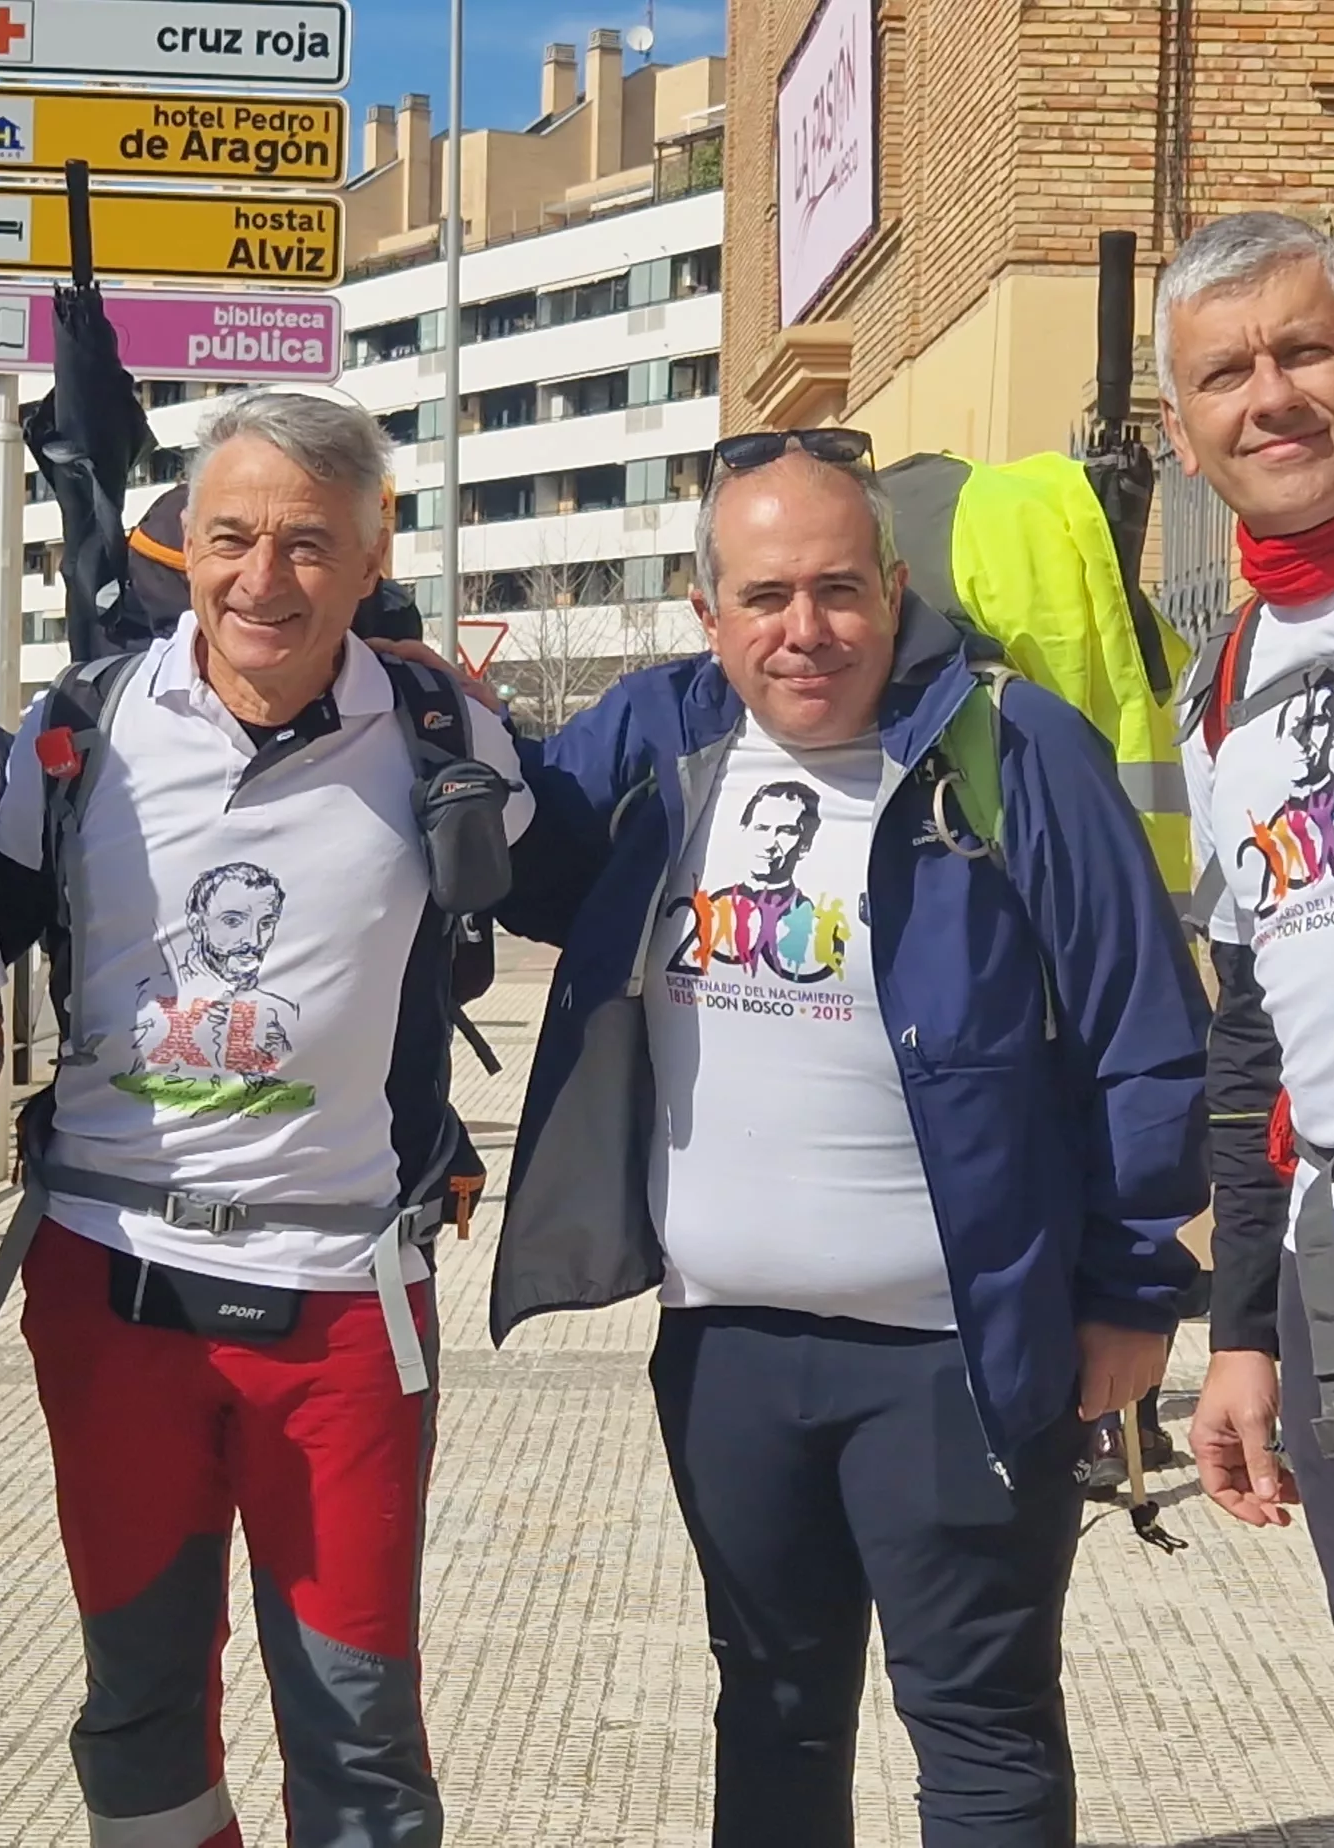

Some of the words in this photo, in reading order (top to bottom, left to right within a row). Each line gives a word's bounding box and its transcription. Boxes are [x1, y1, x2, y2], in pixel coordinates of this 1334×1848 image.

[156, 26, 243, 55] cruz
[256, 21, 330, 62] roja
[153, 104, 225, 129] hotel
[234, 108, 315, 132] Pedro
[323, 110, 330, 134] I
[119, 128, 169, 160] de
[180, 130, 329, 173] Aragón
[234, 206, 326, 233] hostal
[226, 237, 326, 272] Alviz
[213, 305, 325, 329] biblioteca
[187, 328, 324, 366] pública
[706, 994, 738, 1012] DON
[742, 1000, 794, 1017] BOSCO
[812, 1006, 853, 1022] 2015
[744, 985, 765, 998] DEL
[768, 988, 854, 1006] NACIMIENTO
[147, 994, 280, 1073] XL
[217, 1303, 267, 1321] SPORT
